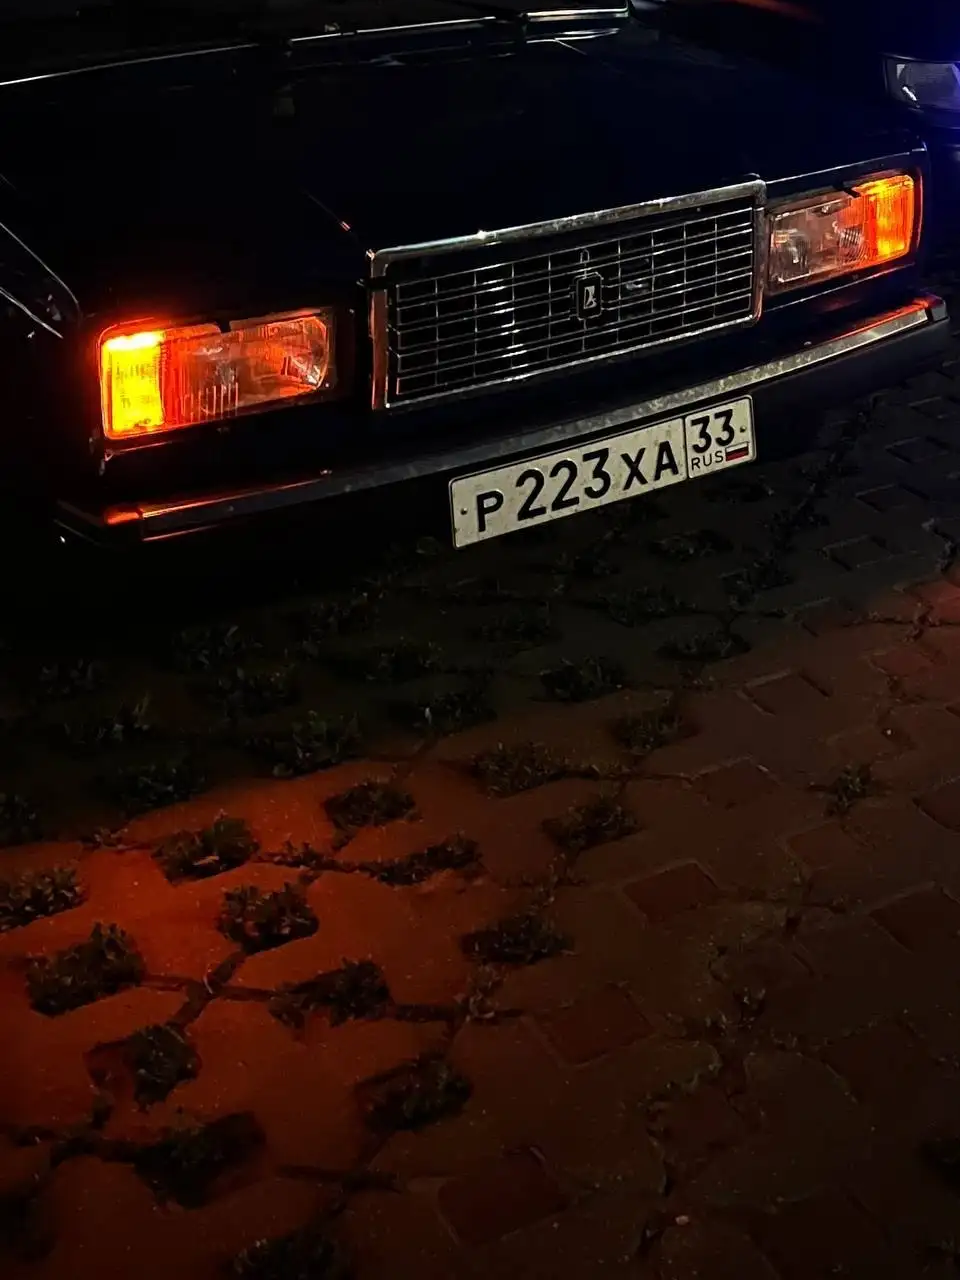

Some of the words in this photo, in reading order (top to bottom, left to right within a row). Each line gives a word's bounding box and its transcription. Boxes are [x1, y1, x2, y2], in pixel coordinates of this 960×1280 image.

[476, 440, 680, 533] Р223ХА
[690, 408, 735, 454] 33
[691, 450, 724, 470] RUS
